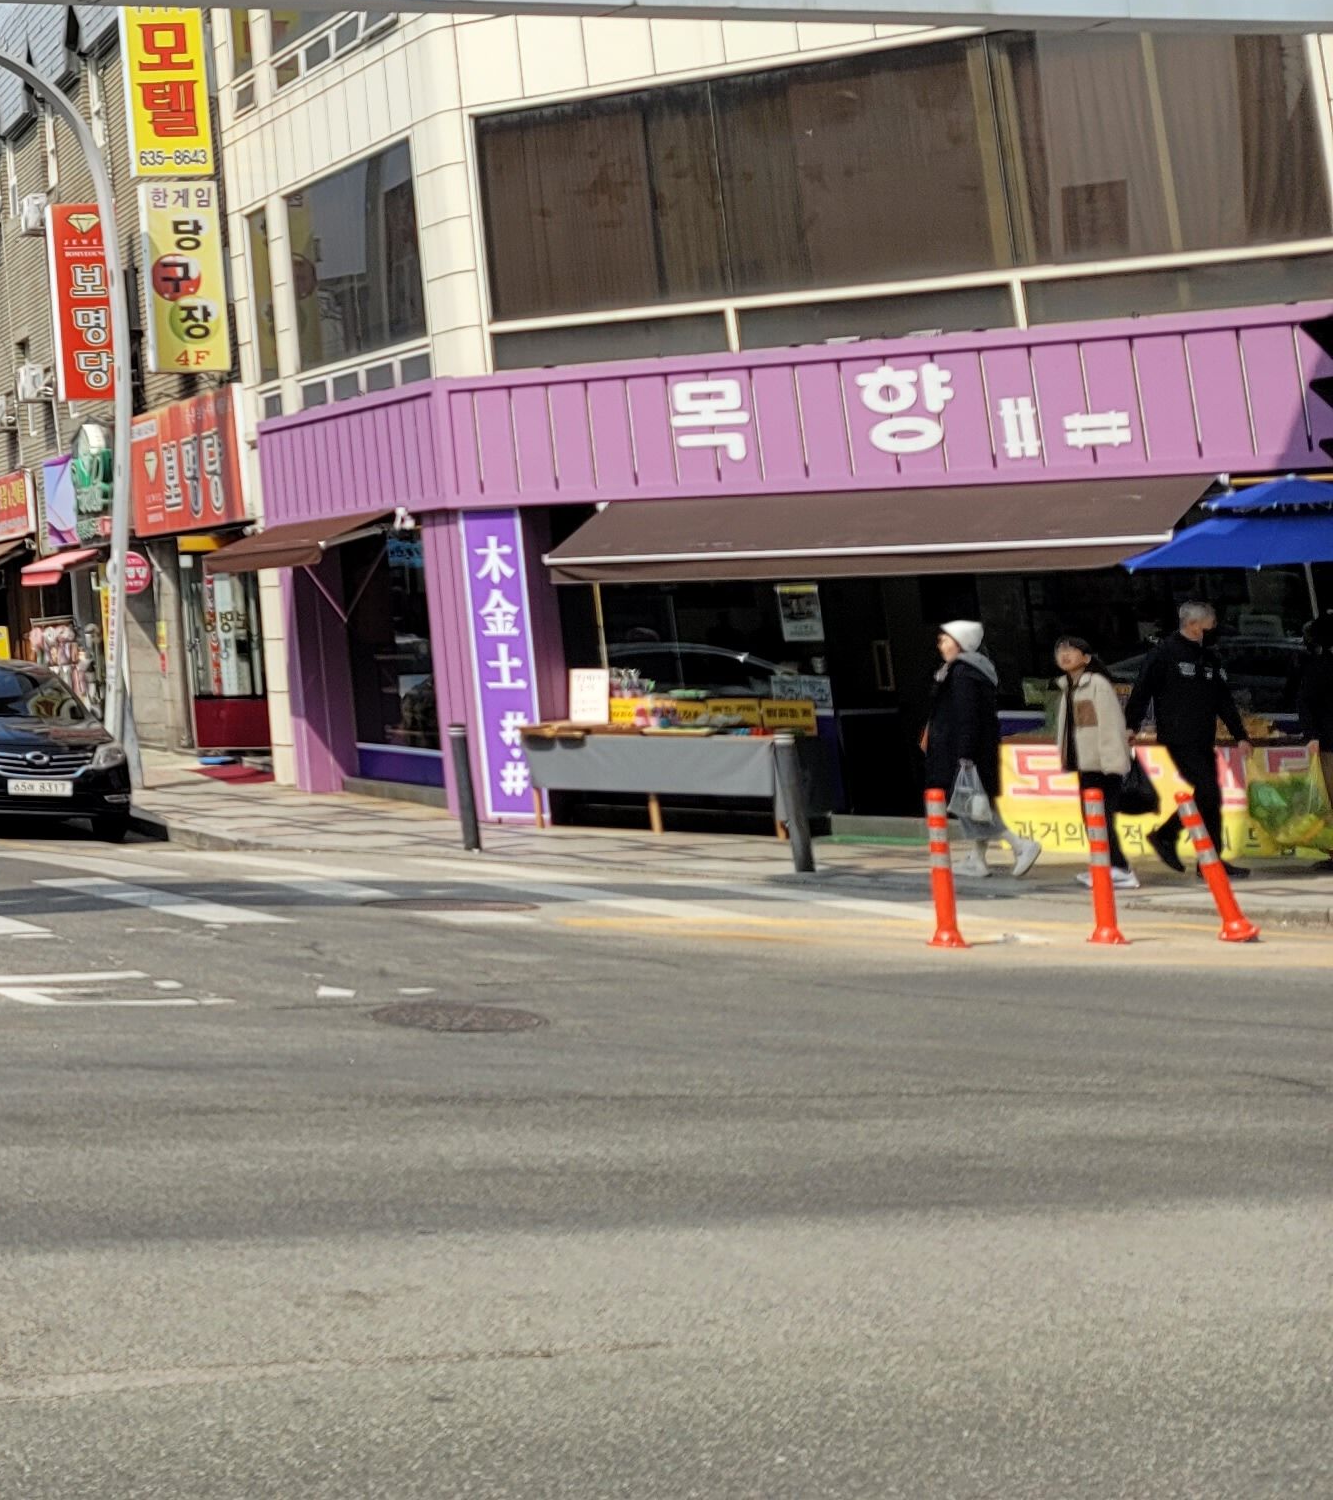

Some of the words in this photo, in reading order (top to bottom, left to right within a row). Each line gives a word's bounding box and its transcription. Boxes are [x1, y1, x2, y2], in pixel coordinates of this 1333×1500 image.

[137, 22, 199, 138] 모텔
[139, 149, 208, 166] 635-8643
[150, 187, 212, 209] 한게임
[69, 263, 115, 388] 보명당
[160, 218, 213, 340] 당구장
[174, 349, 210, 366] 4F
[473, 535, 529, 690] 木金土
